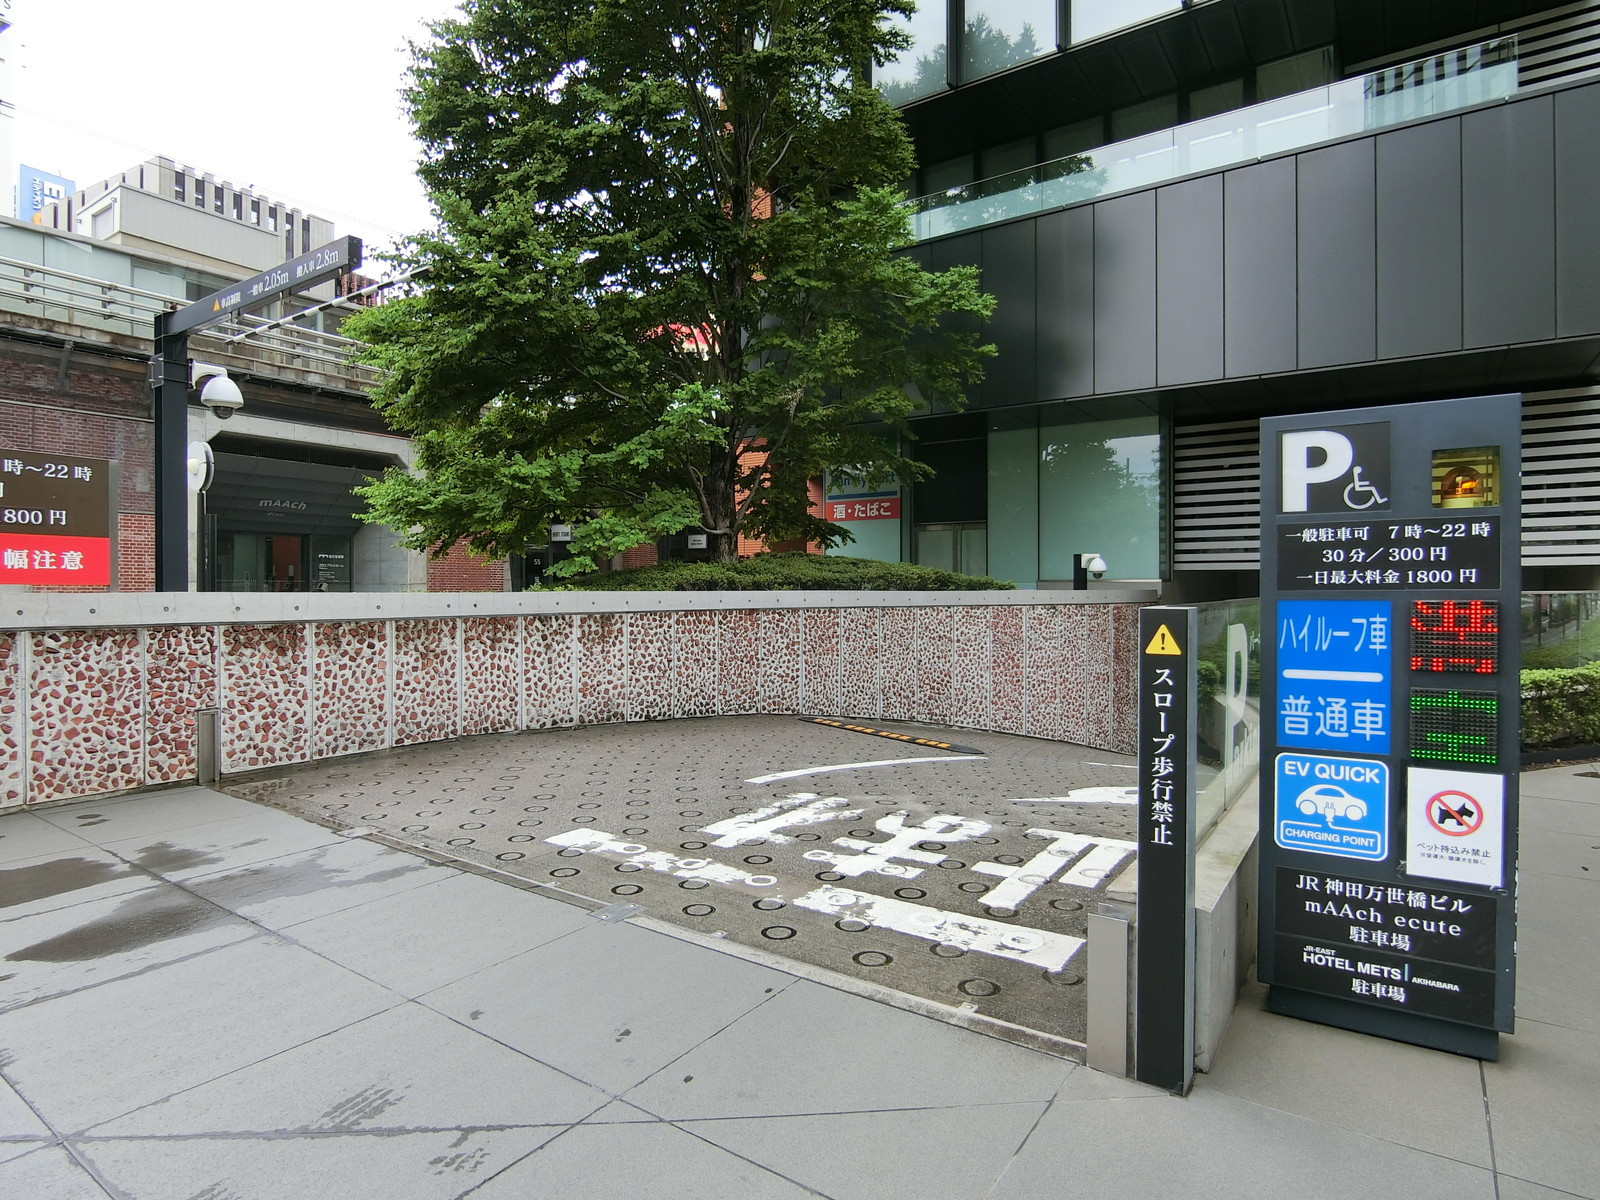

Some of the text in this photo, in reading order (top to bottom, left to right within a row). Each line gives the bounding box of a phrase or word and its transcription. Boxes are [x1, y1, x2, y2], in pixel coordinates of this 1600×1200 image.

[1282, 430, 1353, 513] P
[833, 502, 891, 519] 酒・たばこ
[4, 548, 83, 570] 幅注意
[1280, 614, 1387, 656] ハイルーフ車
[1280, 695, 1386, 741] 普通車
[1151, 668, 1176, 846] スロープ歩行禁止
[1284, 760, 1380, 784] EV QUICK
[1285, 828, 1376, 848] CHARGING POINT
[1304, 899, 1461, 936] mAAch ecute
[1349, 926, 1411, 952] 駐車場
[1303, 952, 1460, 992] HOTEL METS AKIHABARA
[1351, 978, 1406, 1003] 駐車場
